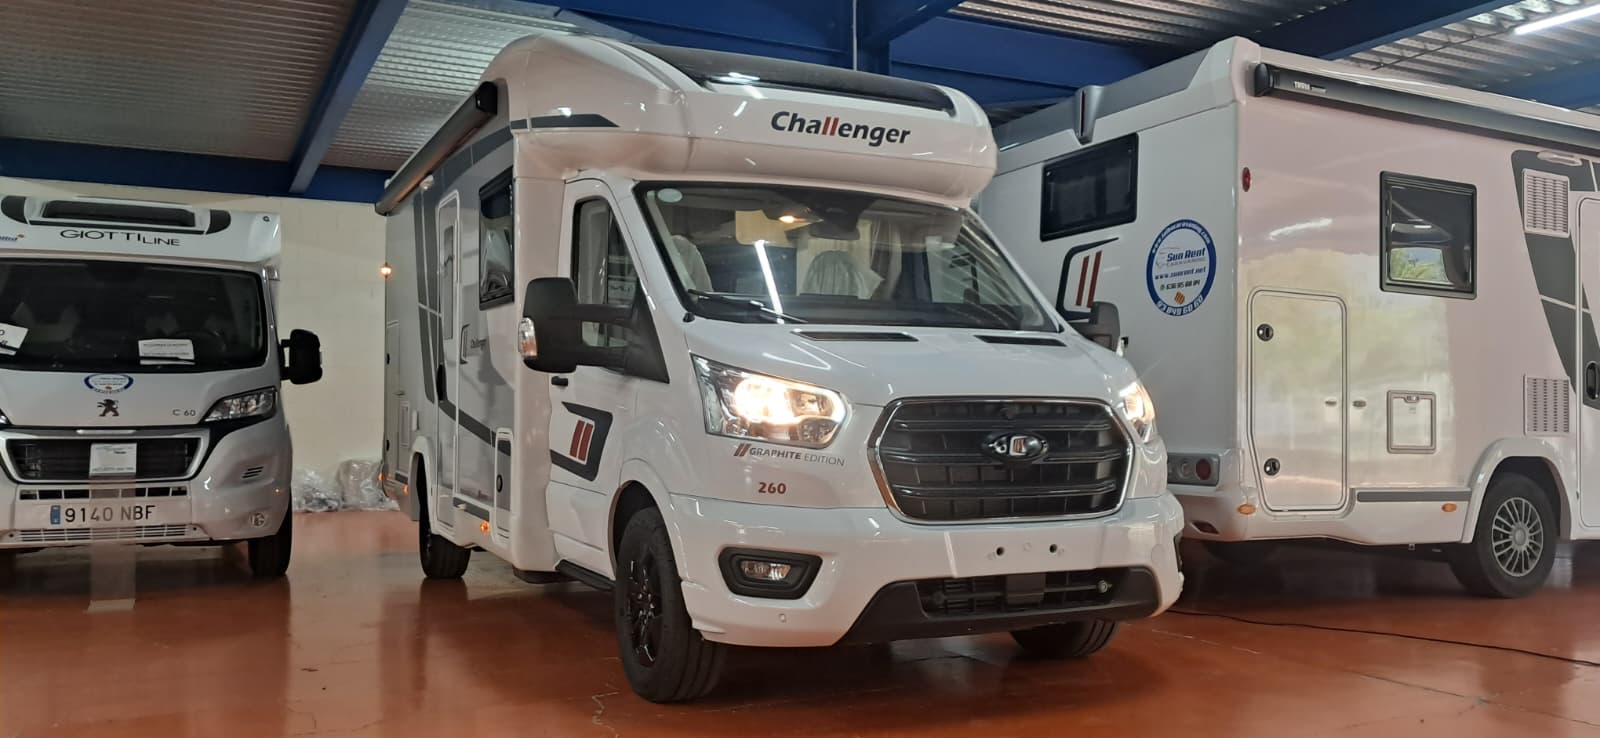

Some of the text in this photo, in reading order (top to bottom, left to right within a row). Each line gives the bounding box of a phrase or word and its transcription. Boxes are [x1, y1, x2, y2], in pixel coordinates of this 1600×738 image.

[771, 111, 911, 147] Challenger
[60, 229, 180, 247] GIOTTILINE
[1166, 247, 1206, 262] Sun Rent
[172, 408, 196, 417] C 60
[749, 446, 845, 467] GRAPHITE EDITION
[758, 481, 787, 494] 260
[65, 504, 156, 523] 9140 NBF
